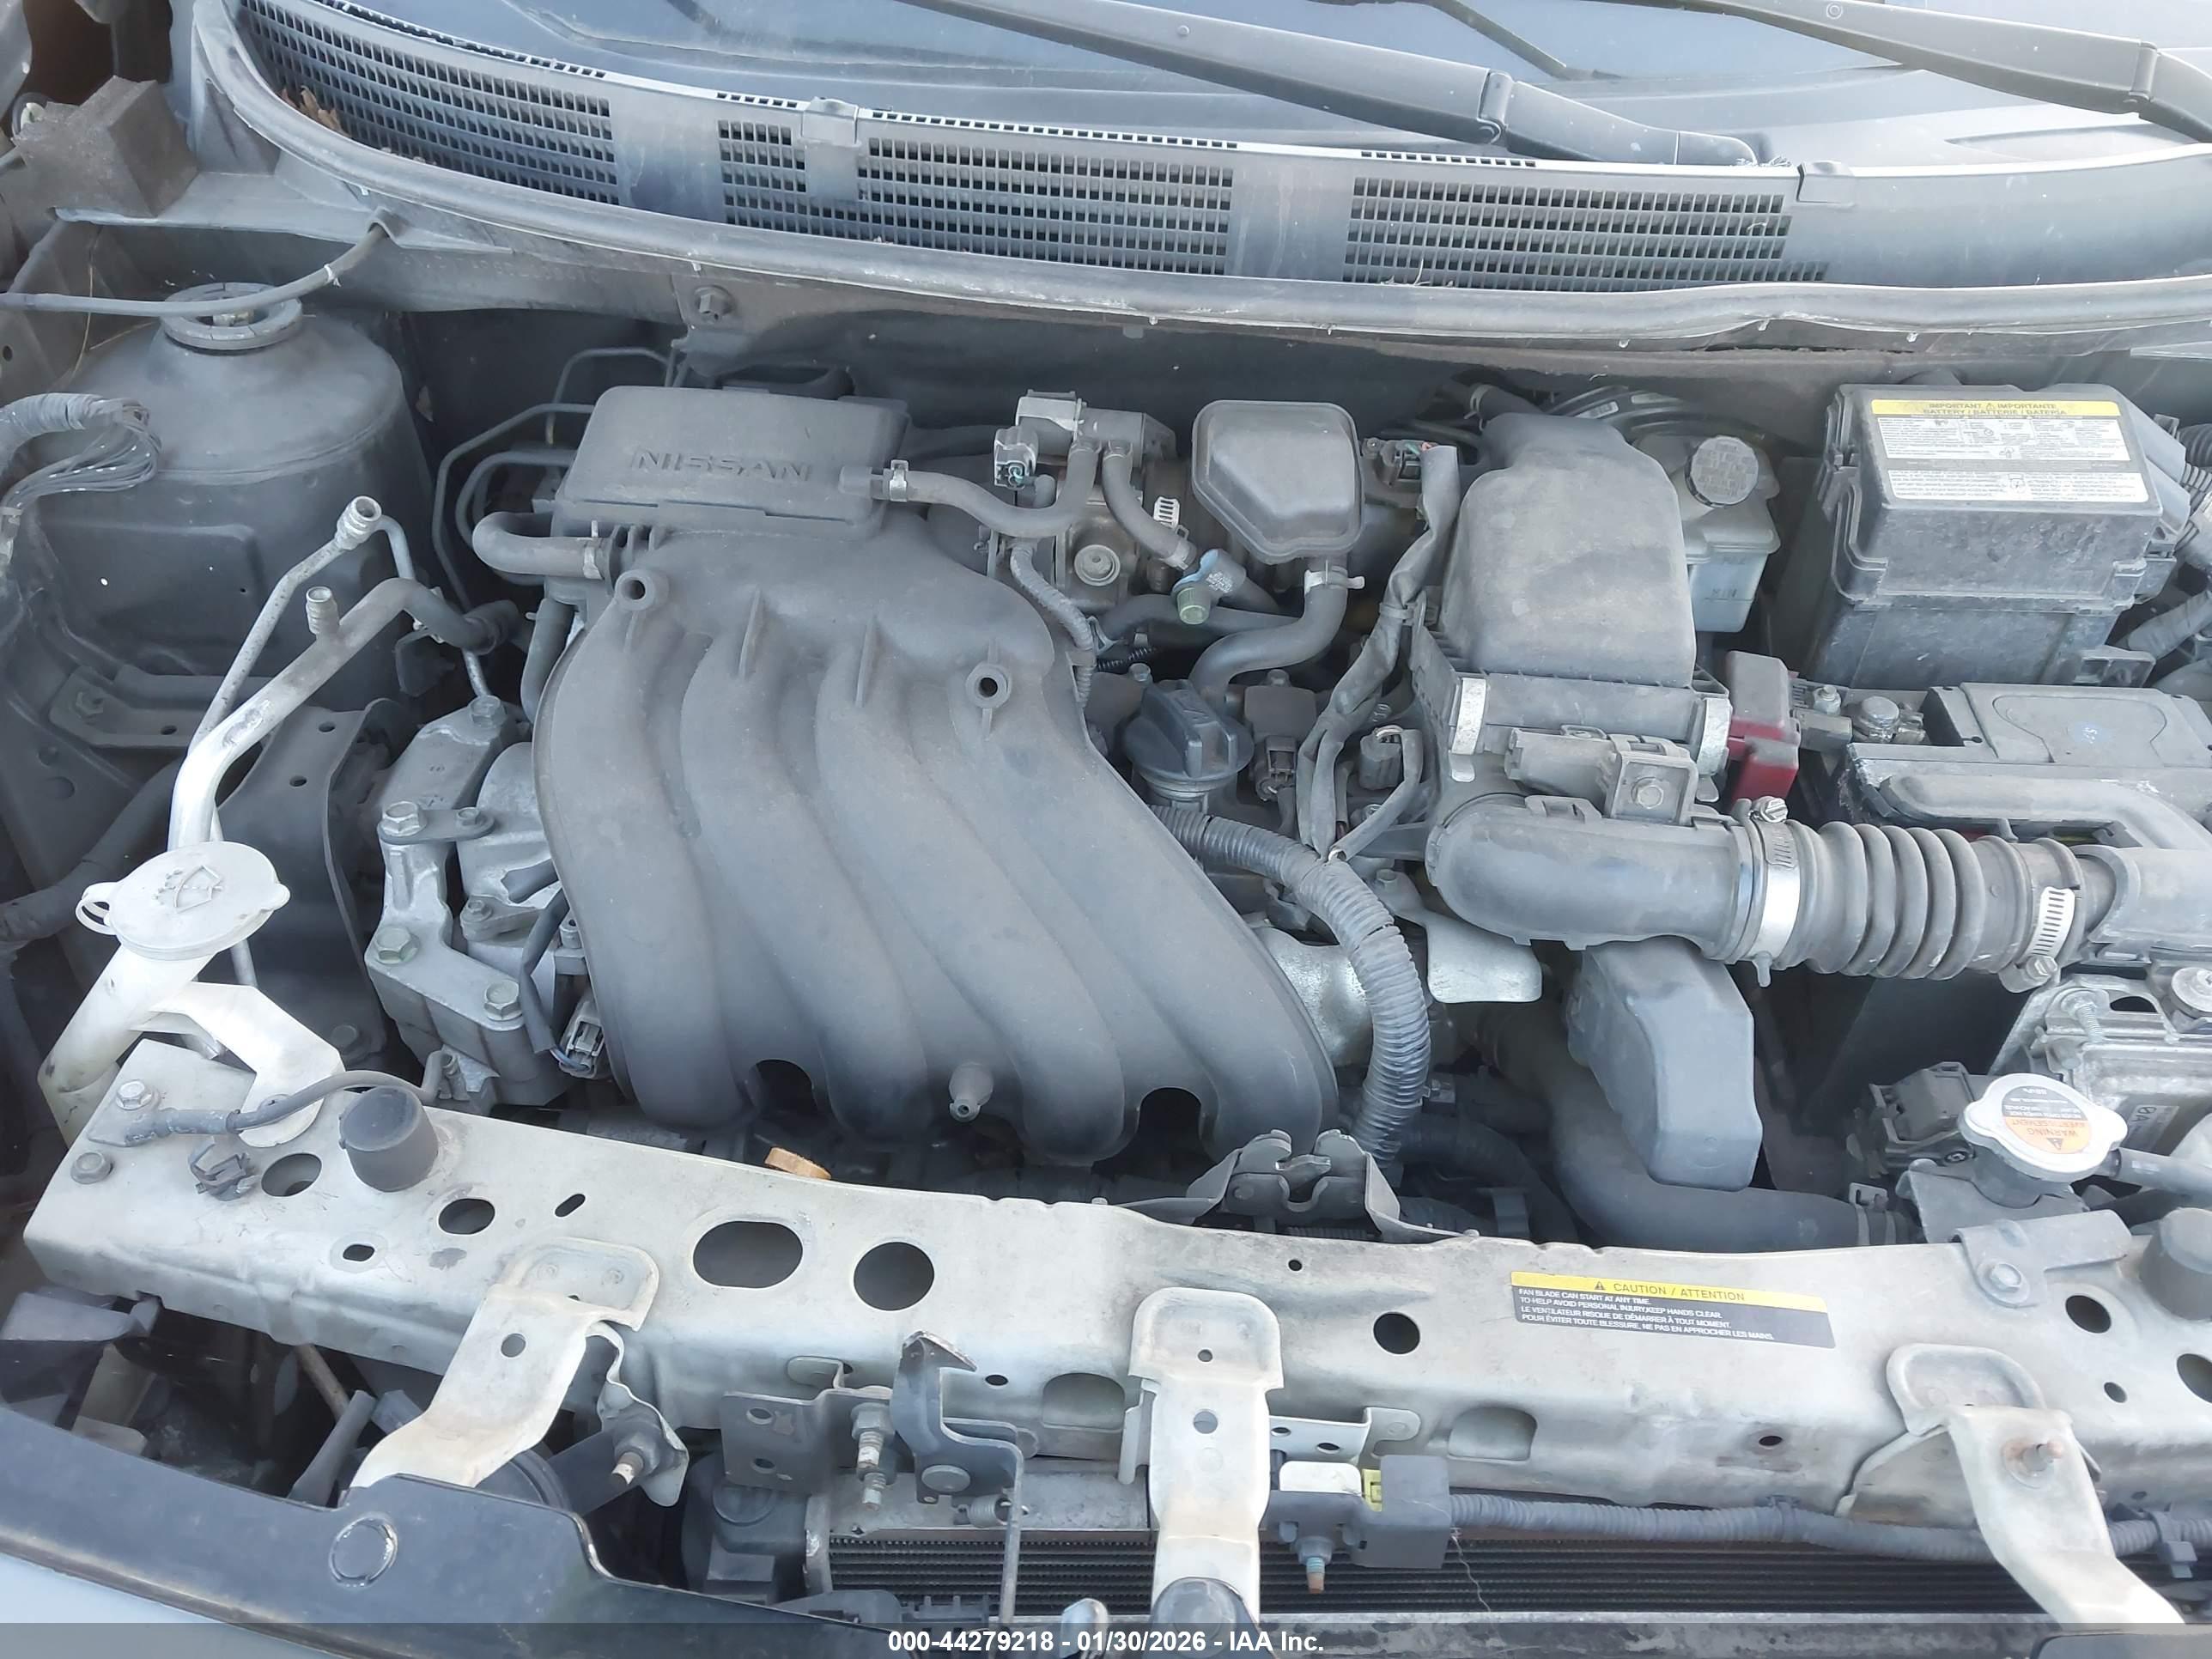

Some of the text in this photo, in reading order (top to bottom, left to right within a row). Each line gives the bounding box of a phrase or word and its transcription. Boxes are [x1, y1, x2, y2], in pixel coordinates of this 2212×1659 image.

[631, 450, 813, 482] NISSAN
[1613, 1283, 1745, 1301] CAUTION / ATTENTION
[1532, 1307, 1581, 1316] VENTILATEUR
[1583, 1310, 1612, 1319] RISQUE
[1625, 1313, 1667, 1323] DÉMARRER
[1696, 1319, 1732, 1328] MOMENT.
[1578, 1301, 1619, 1311] PERSONAL
[1667, 1308, 1694, 1316] HANDS
[1695, 1310, 1723, 1319] CLEAR.
[1573, 1317, 1598, 1326] TOUTE
[1683, 1327, 1731, 1337] APPROCHER
